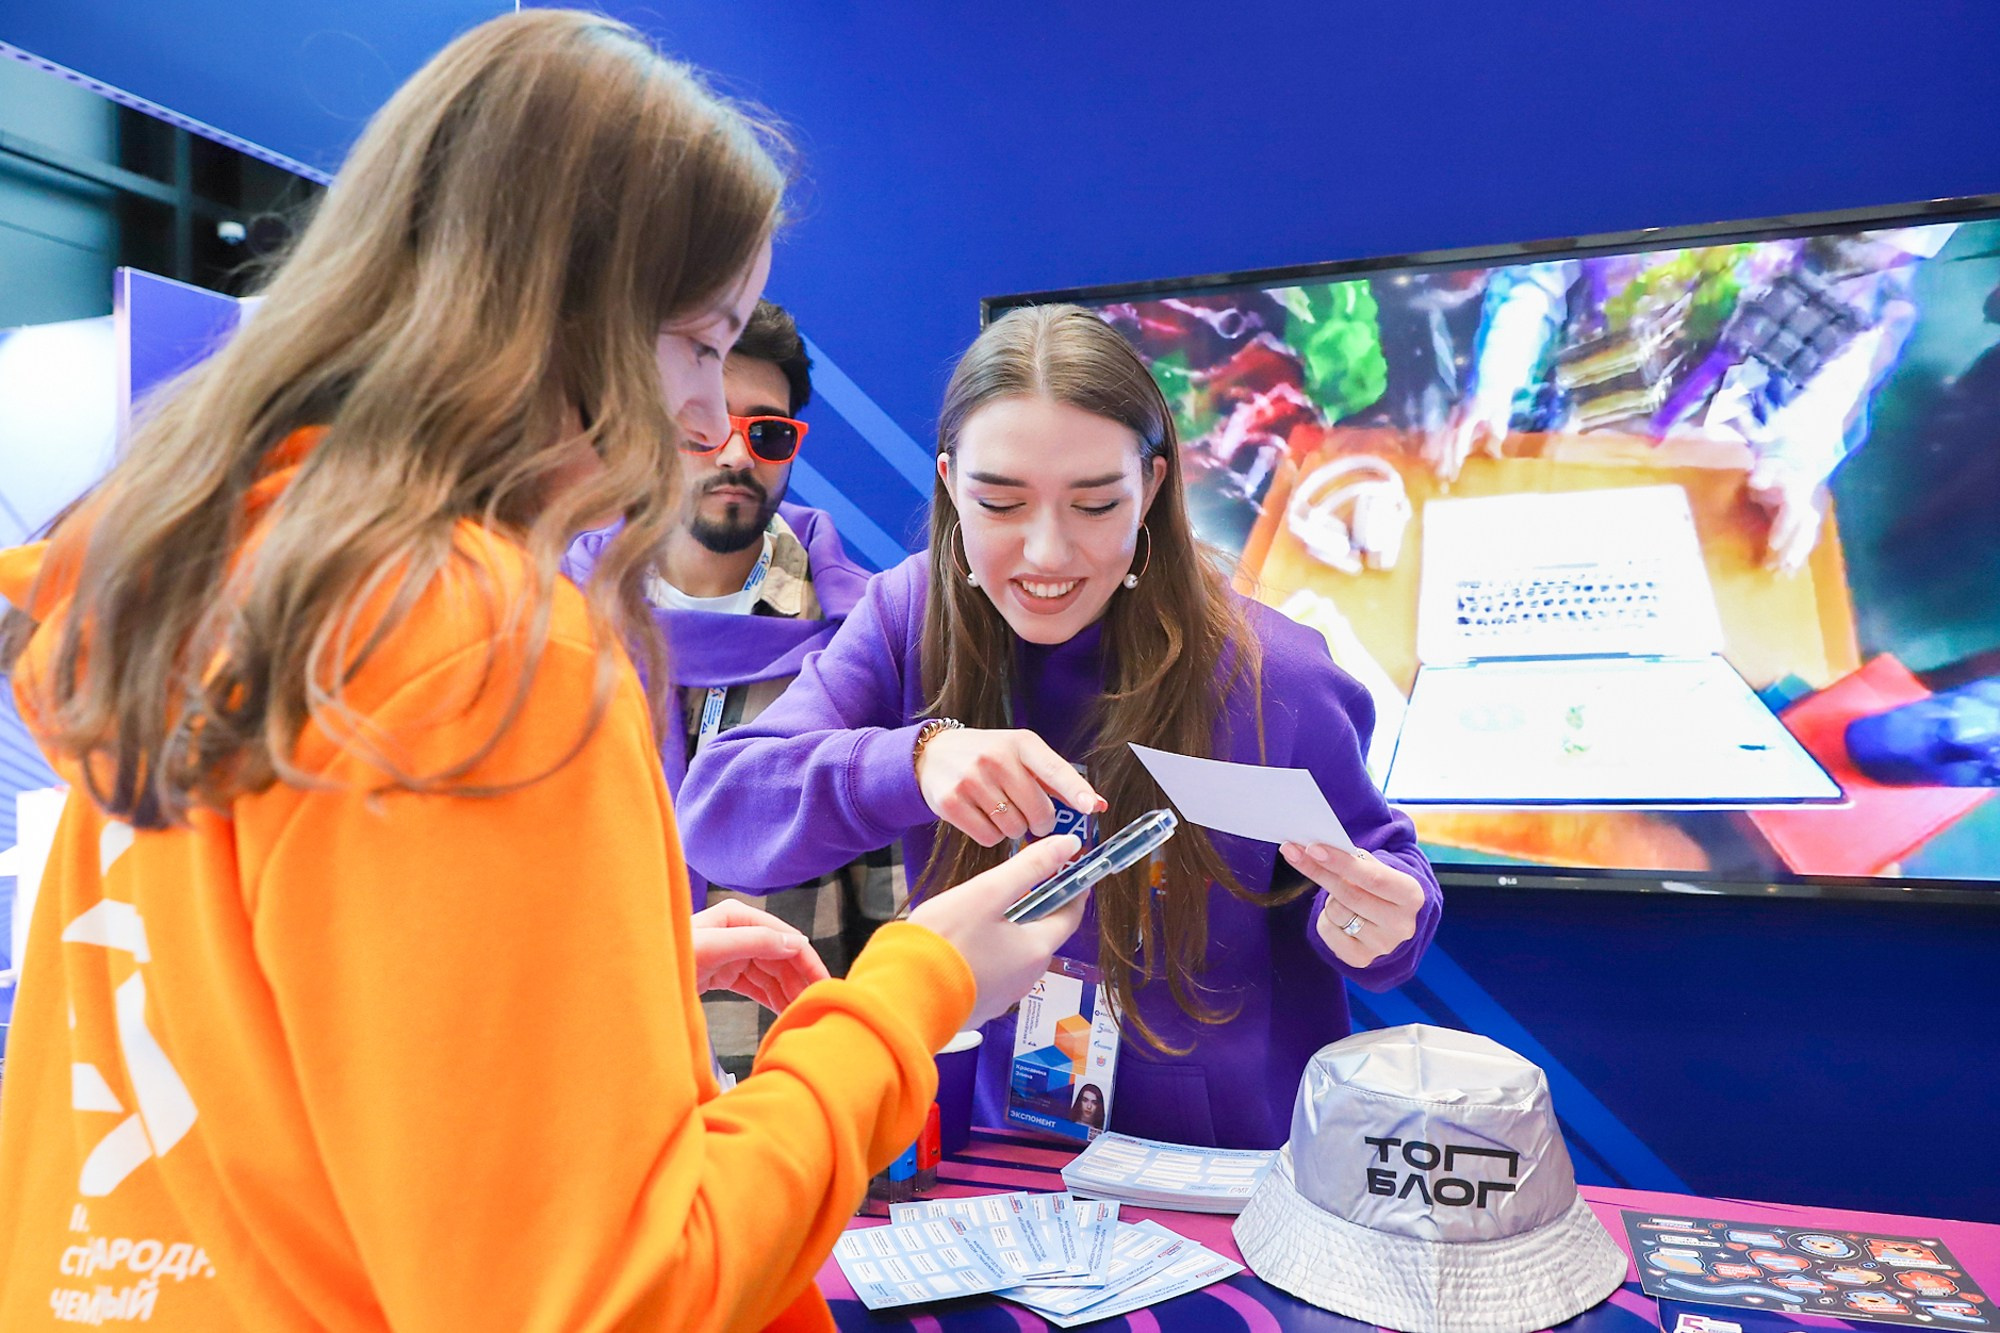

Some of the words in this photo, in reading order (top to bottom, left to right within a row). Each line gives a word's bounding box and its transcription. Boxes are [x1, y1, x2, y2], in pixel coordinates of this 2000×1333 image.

[1010, 1110, 1056, 1128] ЭКСПОНЕНТ
[1364, 1136, 1520, 1178] ТОП
[1366, 1168, 1517, 1209] БЛОГ
